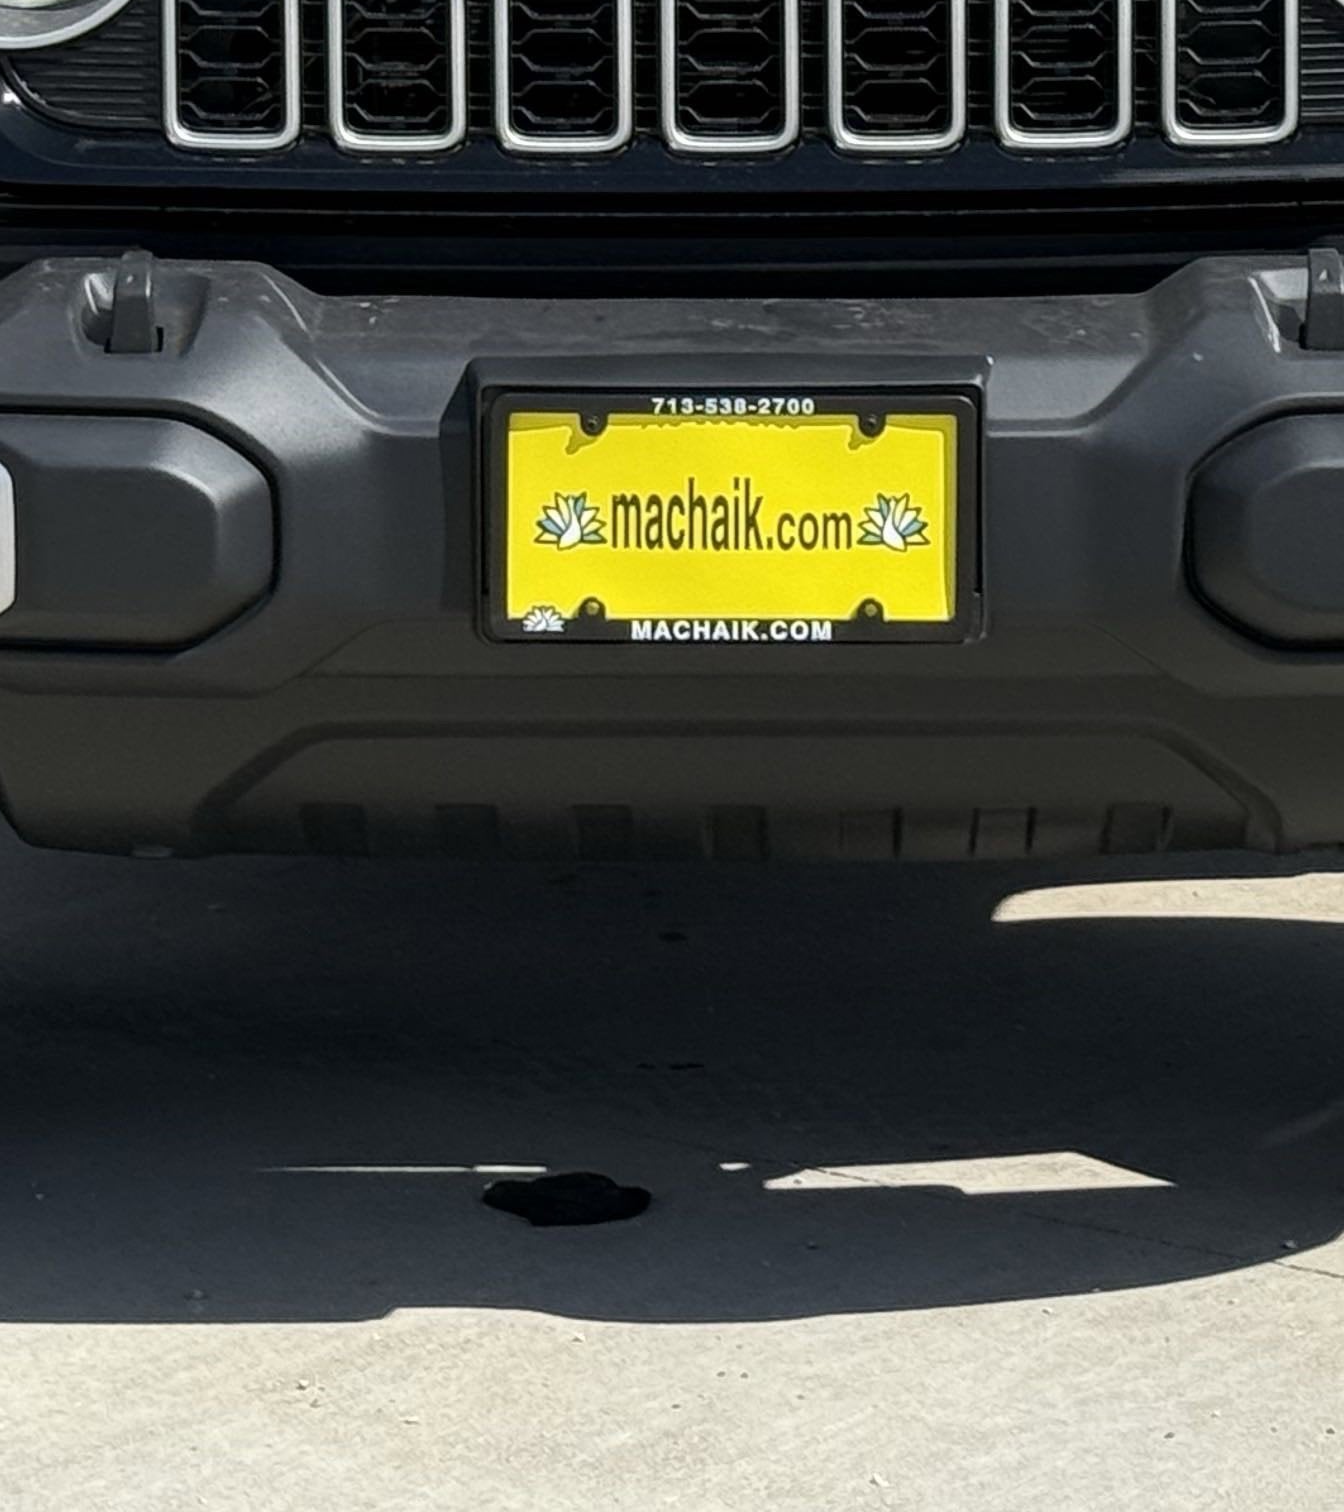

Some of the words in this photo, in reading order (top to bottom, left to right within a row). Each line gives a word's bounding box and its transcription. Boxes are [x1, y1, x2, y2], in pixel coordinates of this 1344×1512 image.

[651, 397, 815, 415] 713-538-2700
[611, 477, 852, 550] machaik.com
[631, 621, 833, 642] MACHAIK.COM
